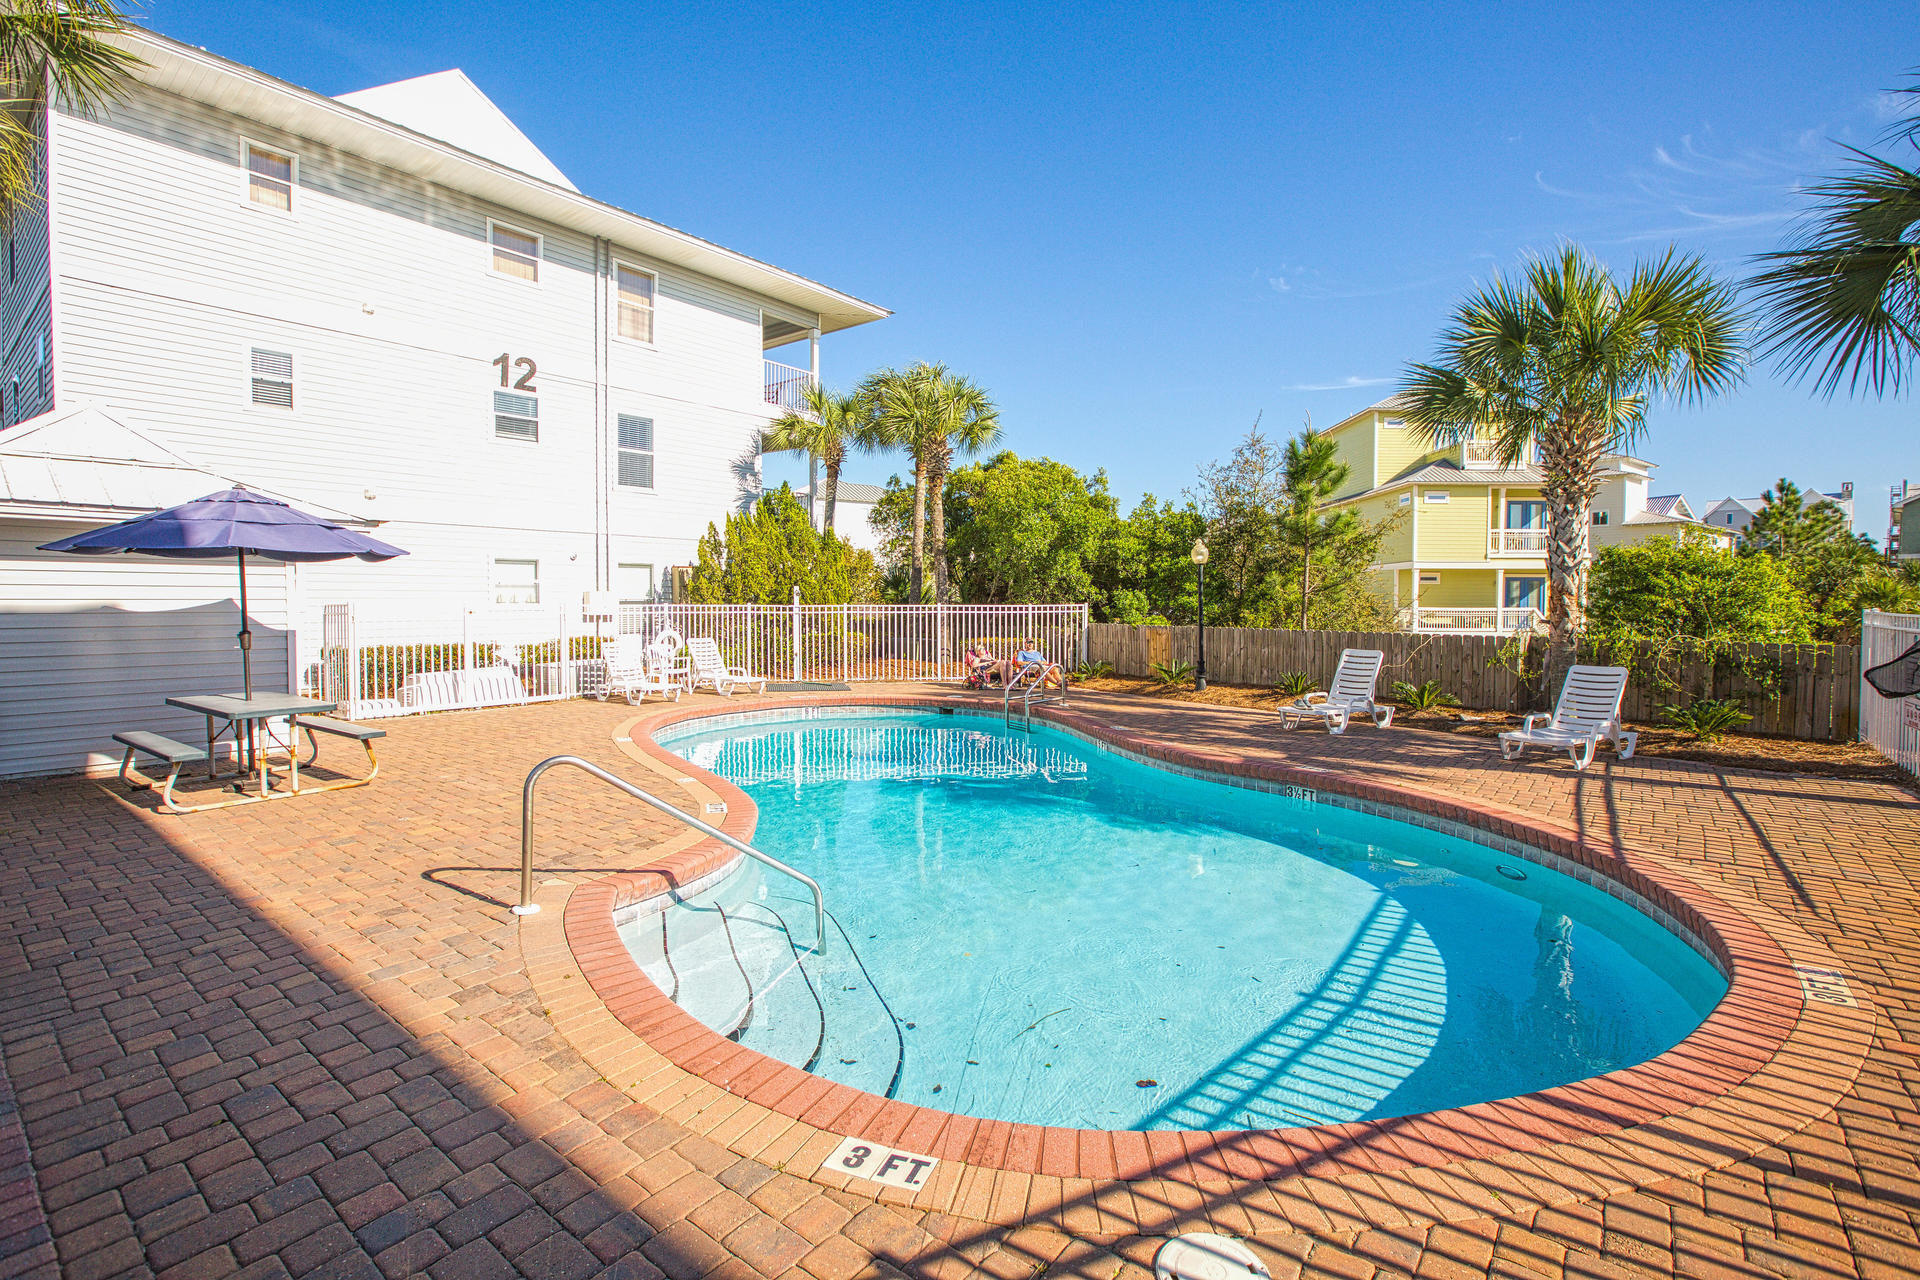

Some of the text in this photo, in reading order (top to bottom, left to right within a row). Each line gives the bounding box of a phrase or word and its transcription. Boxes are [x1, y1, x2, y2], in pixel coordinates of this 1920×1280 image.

[493, 353, 537, 393] 12
[842, 1145, 932, 1185] 3 FT.
